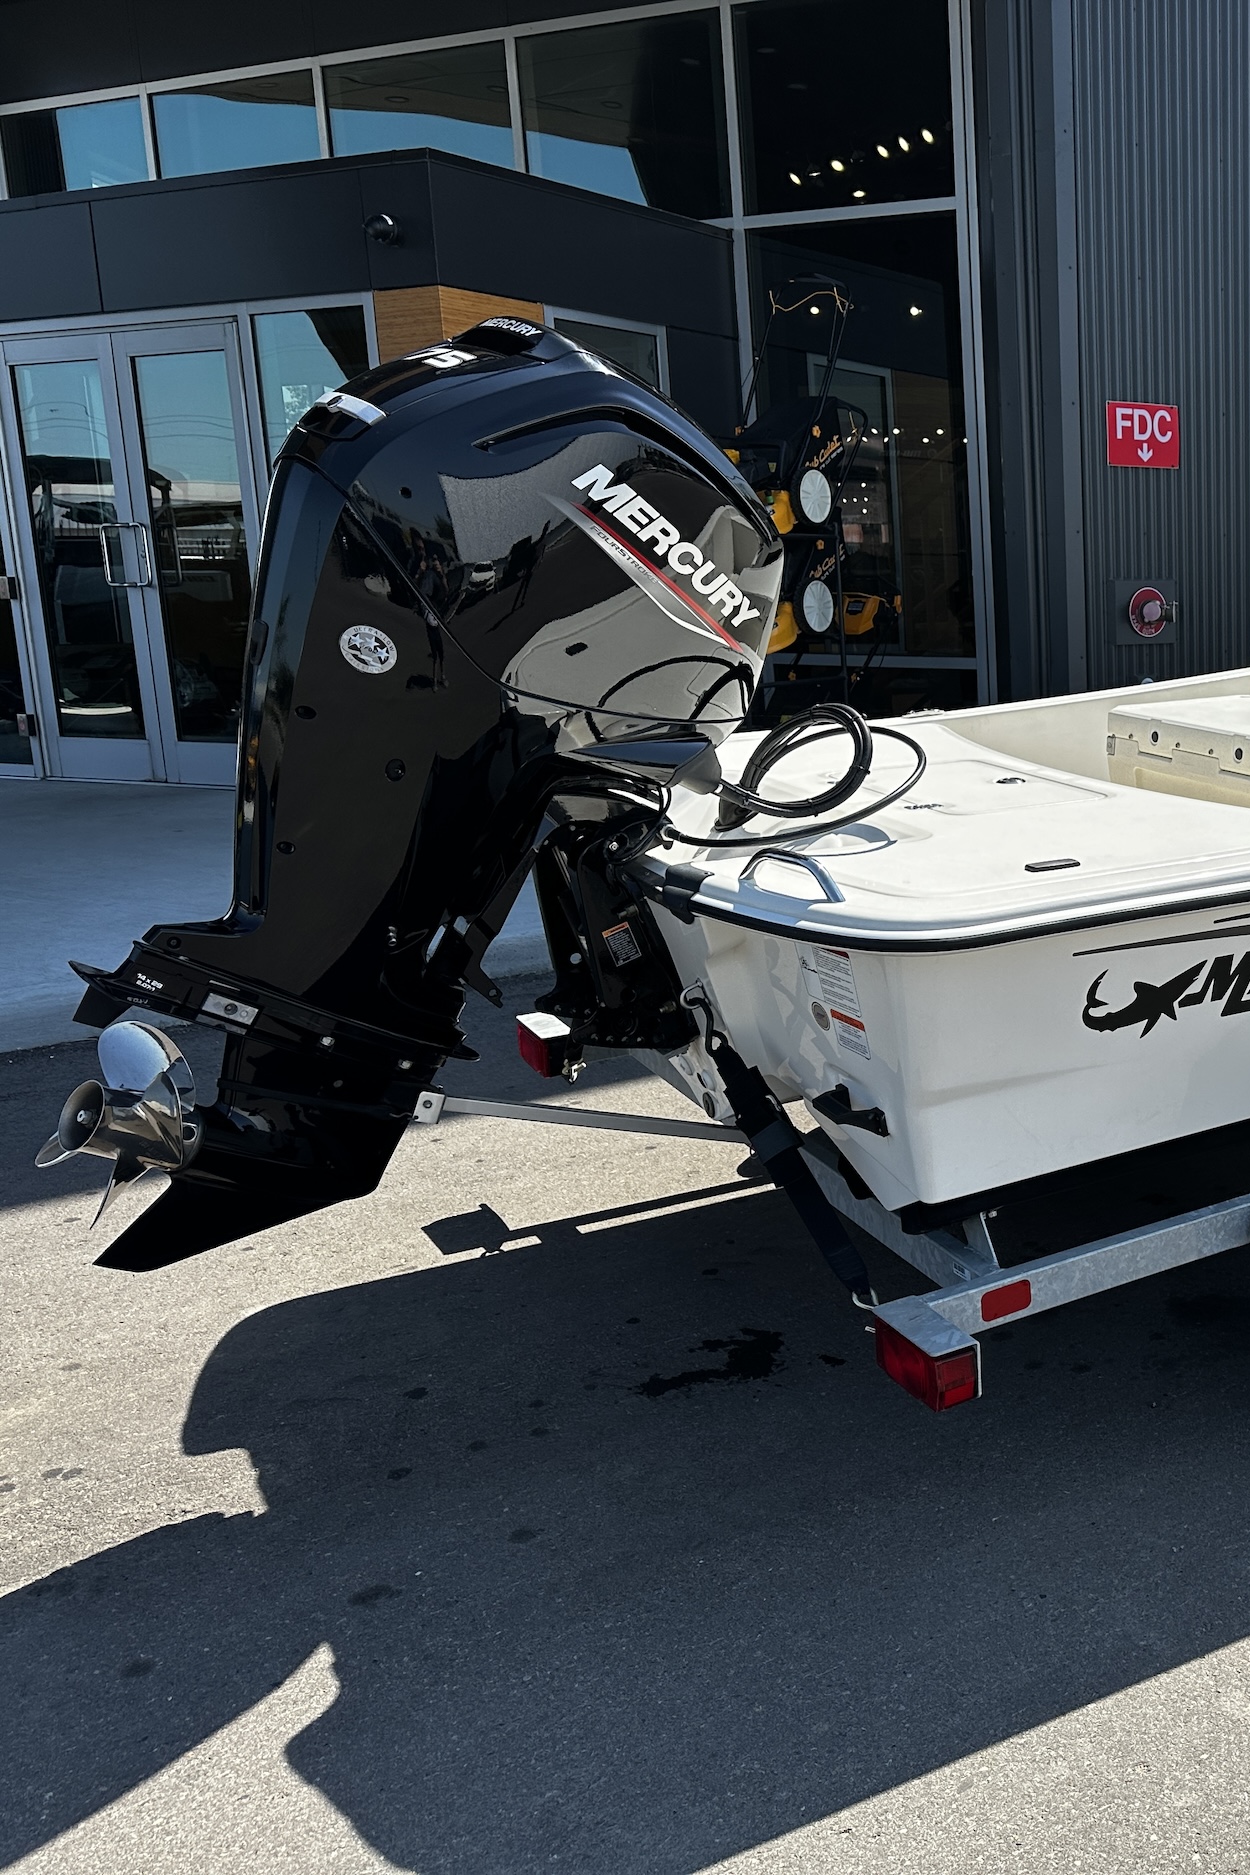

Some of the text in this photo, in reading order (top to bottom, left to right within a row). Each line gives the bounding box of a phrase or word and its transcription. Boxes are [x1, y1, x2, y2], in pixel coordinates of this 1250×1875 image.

[479, 318, 543, 336] MERCURY
[1115, 407, 1172, 443] FDC
[571, 463, 761, 628] MERCURY
[589, 525, 660, 584] FOURSTROKE
